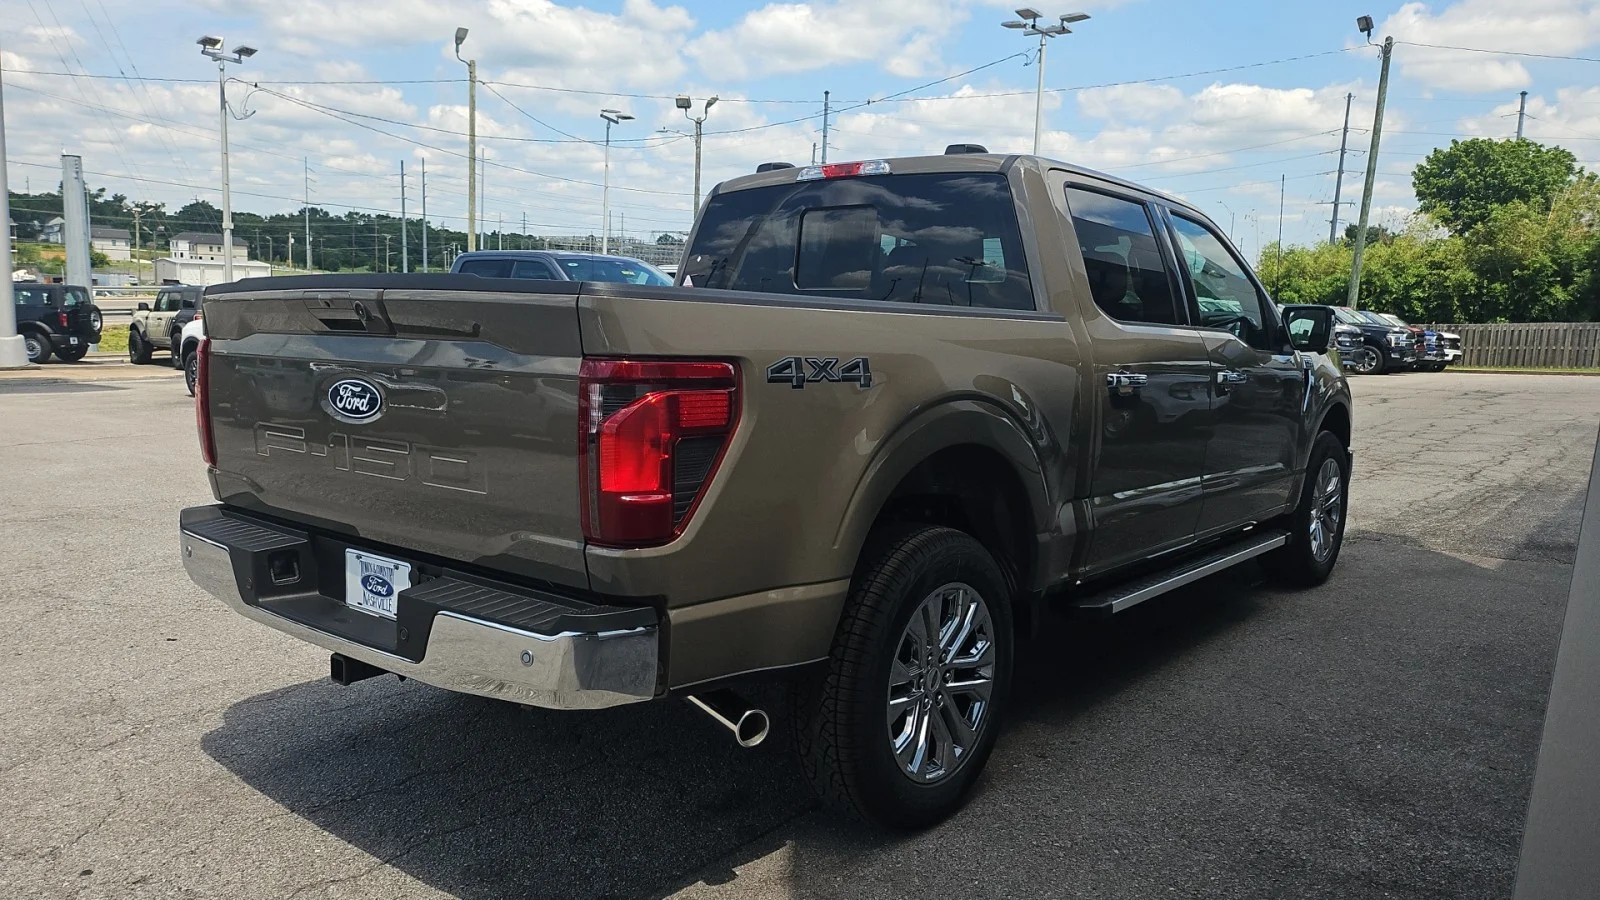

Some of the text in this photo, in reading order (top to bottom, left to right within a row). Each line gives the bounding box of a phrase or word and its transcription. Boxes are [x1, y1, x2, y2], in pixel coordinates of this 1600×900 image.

[336, 384, 371, 412] Ford
[253, 421, 487, 494] F-150
[366, 575, 388, 595] Ford
[362, 589, 393, 612] NASHVILLE
